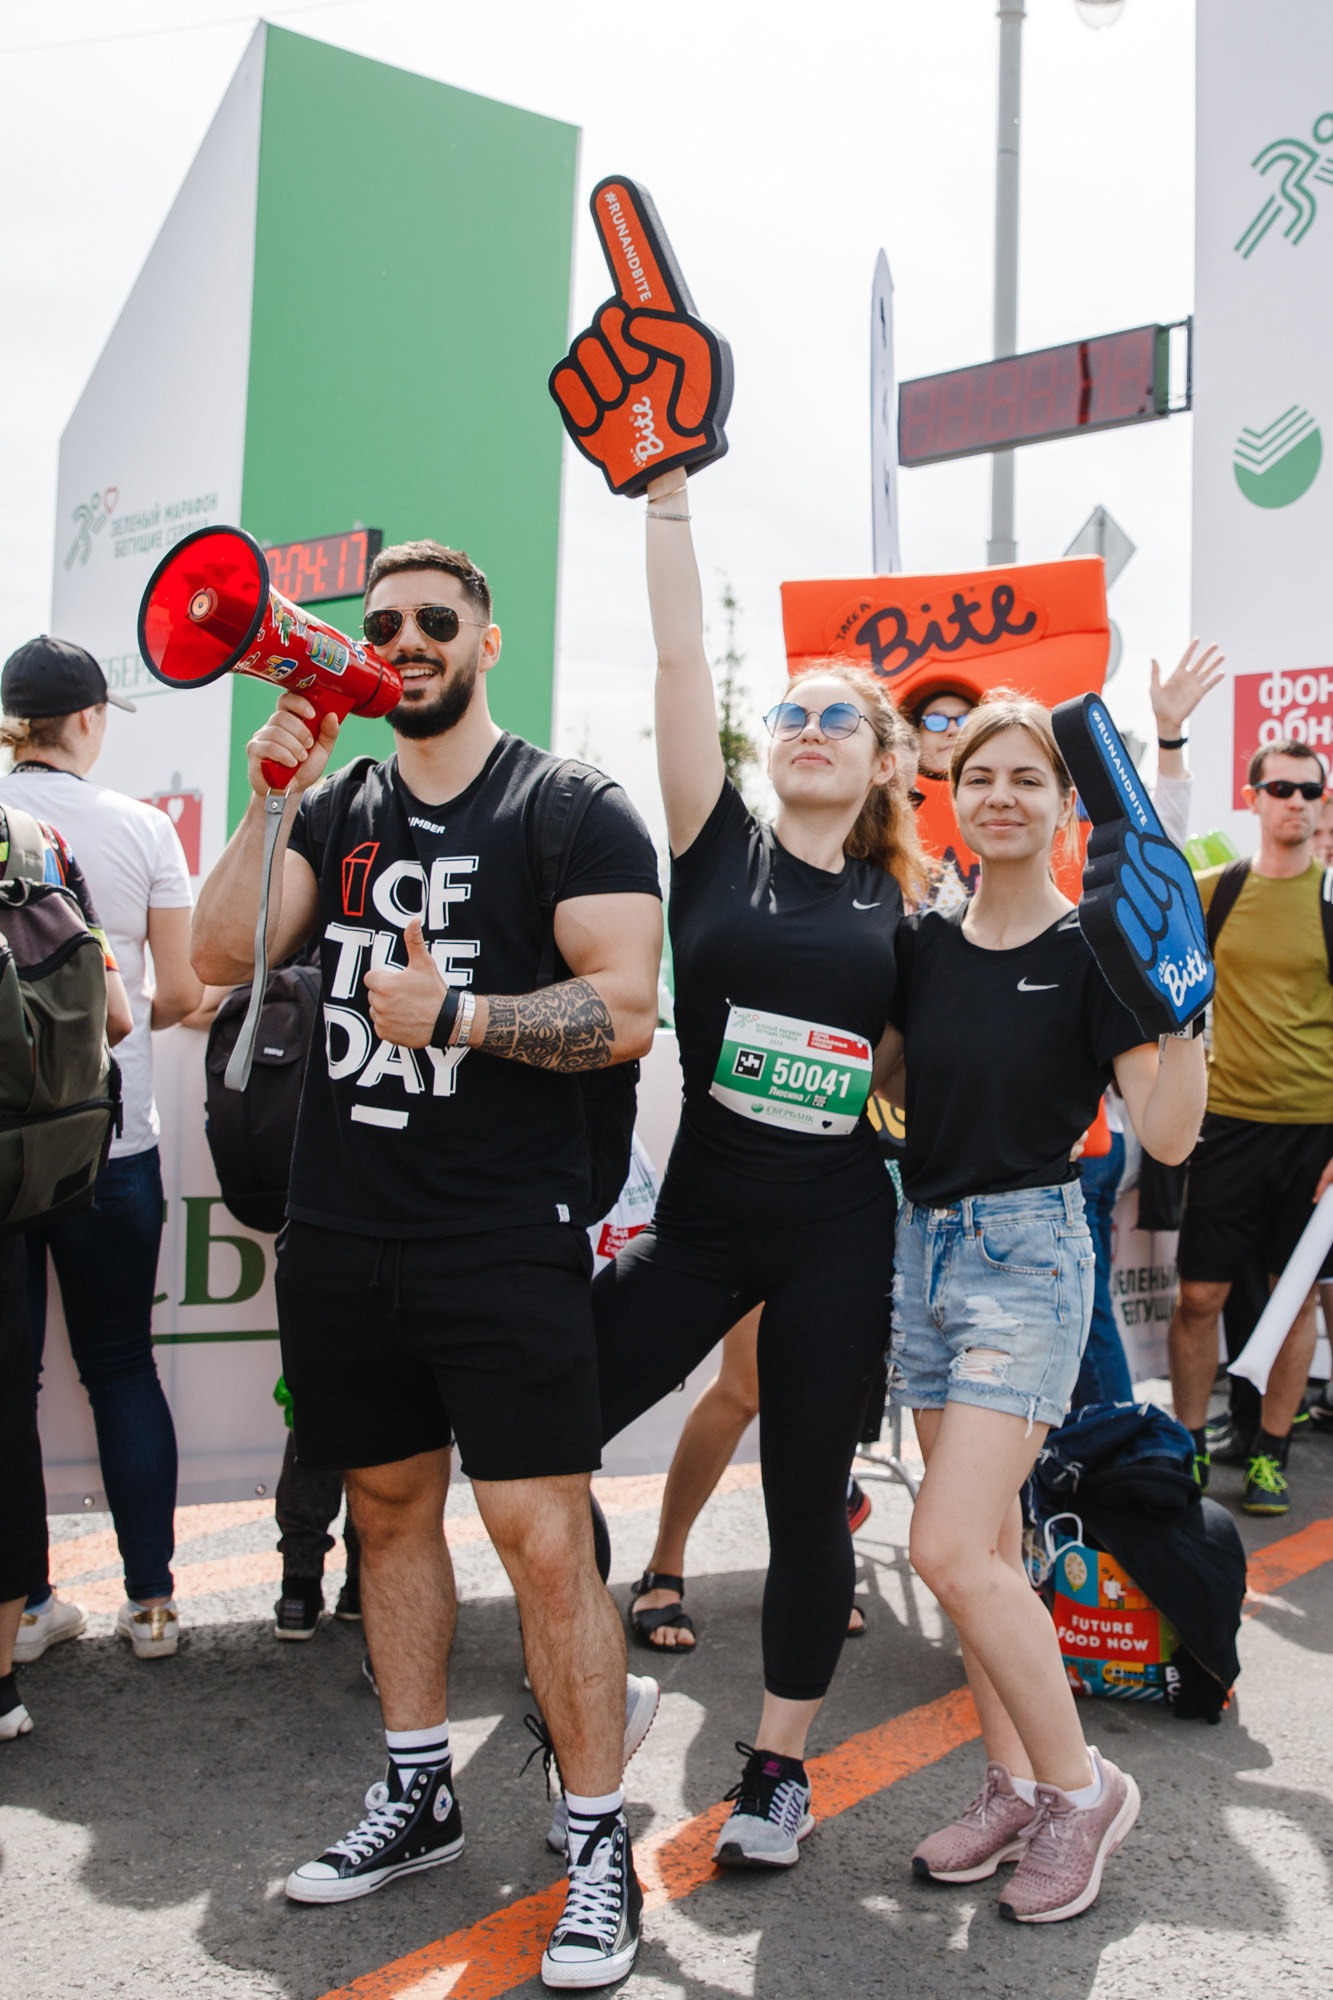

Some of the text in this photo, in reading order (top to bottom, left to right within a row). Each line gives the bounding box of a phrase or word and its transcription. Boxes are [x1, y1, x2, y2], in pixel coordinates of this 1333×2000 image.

[604, 191, 652, 303] #RUNANDBITE
[855, 585, 1037, 678] Bite
[1092, 710, 1148, 826] #RUNANDBITE
[372, 856, 479, 931] OF
[772, 1057, 852, 1098] 50041
[1058, 1626, 1149, 1652] FOOD NOW
[1071, 1615, 1134, 1635] FUTURE
